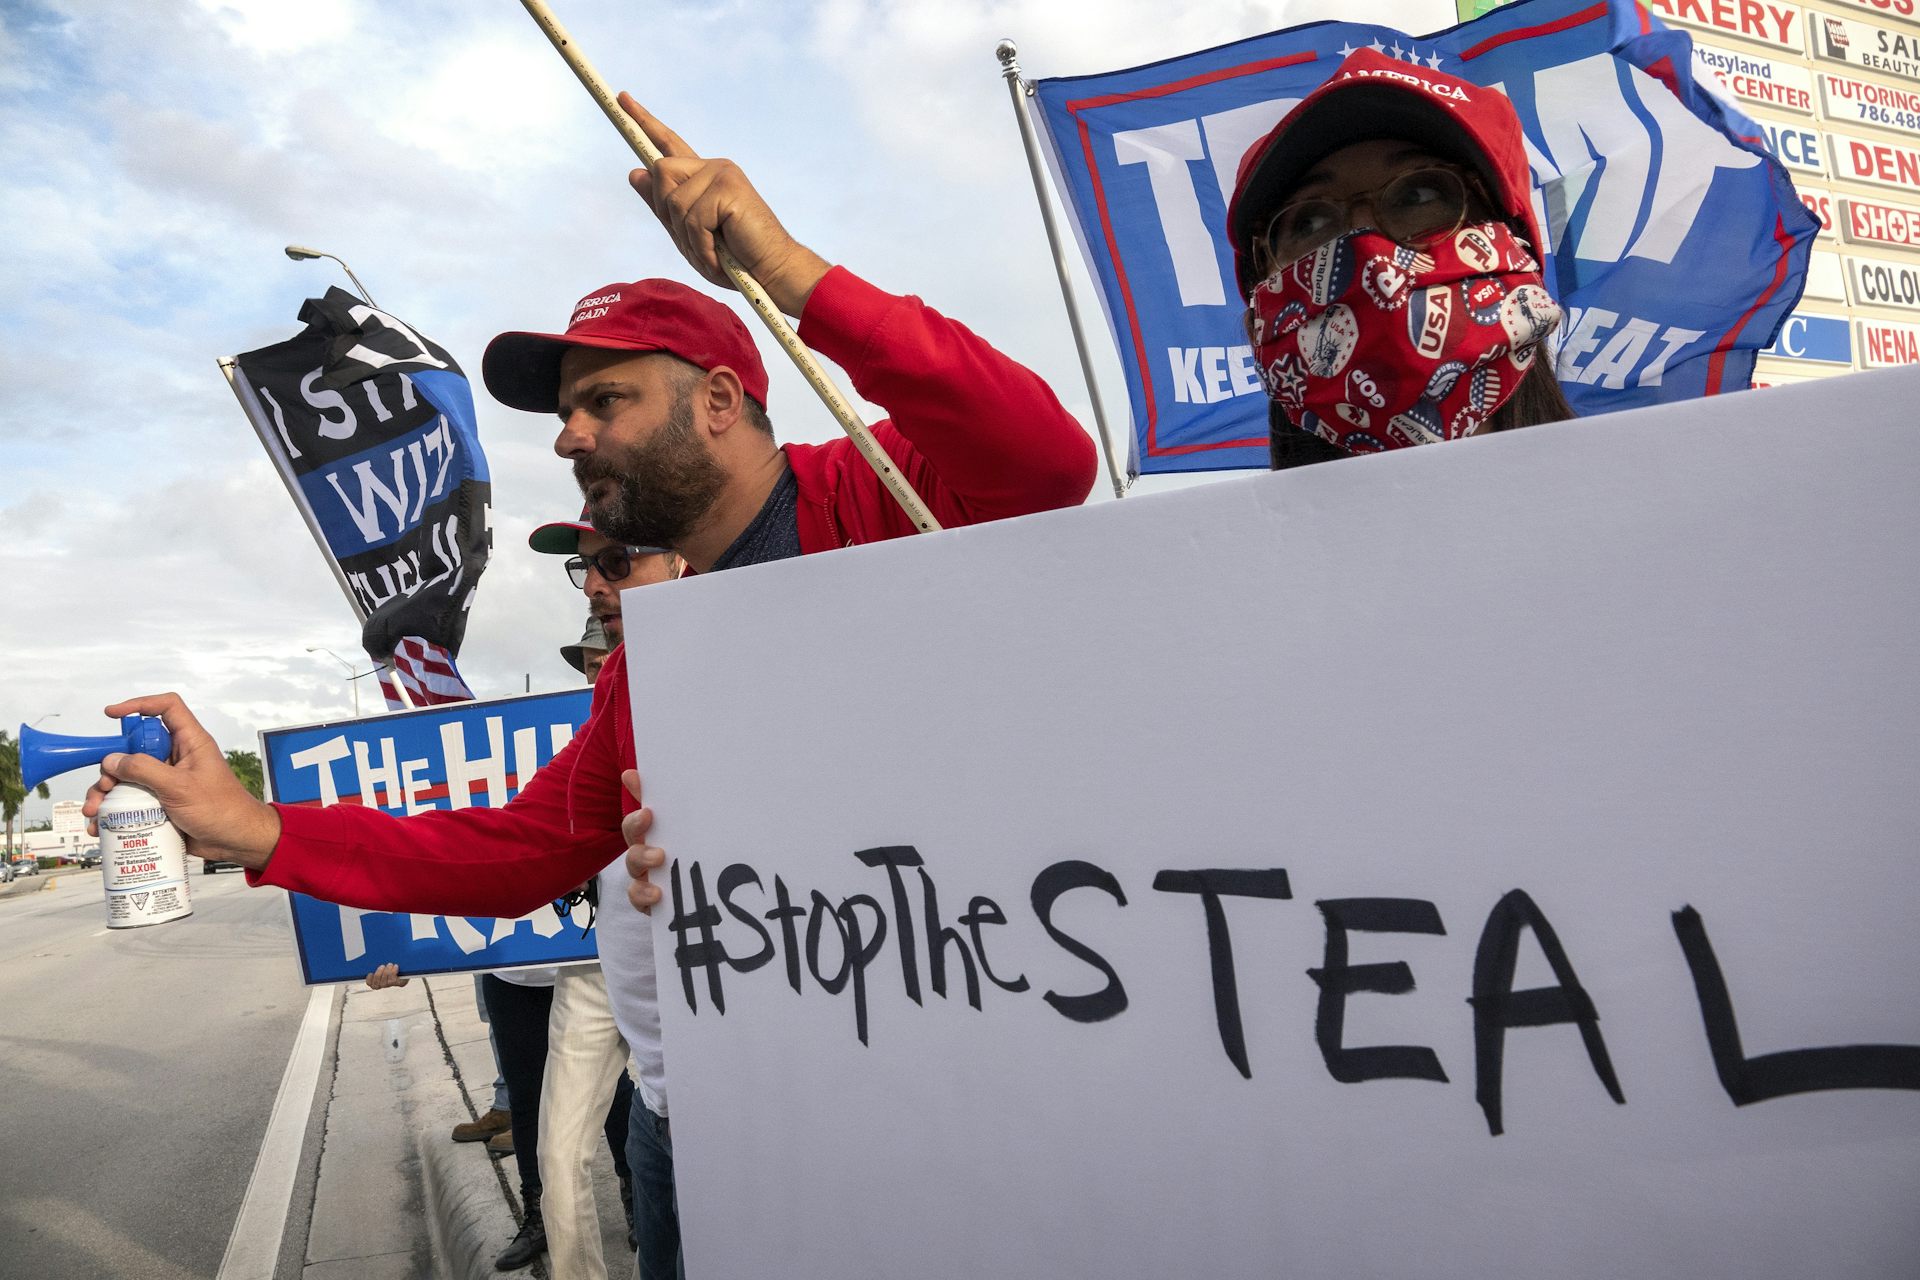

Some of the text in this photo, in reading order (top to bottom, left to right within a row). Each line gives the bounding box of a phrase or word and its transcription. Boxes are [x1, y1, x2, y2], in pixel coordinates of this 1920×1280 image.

[1862, 53, 1919, 77] BEAUTY
[1732, 75, 1811, 110] CENTER
[1827, 76, 1920, 113] TUTORING
[1849, 141, 1920, 187] DEN
[1473, 284, 1495, 302] USA
[1330, 321, 1345, 337] USA
[1421, 292, 1448, 353] USA
[1351, 369, 1386, 409] GOP
[123, 838, 148, 849] HORN
[120, 862, 157, 875] KLAXON
